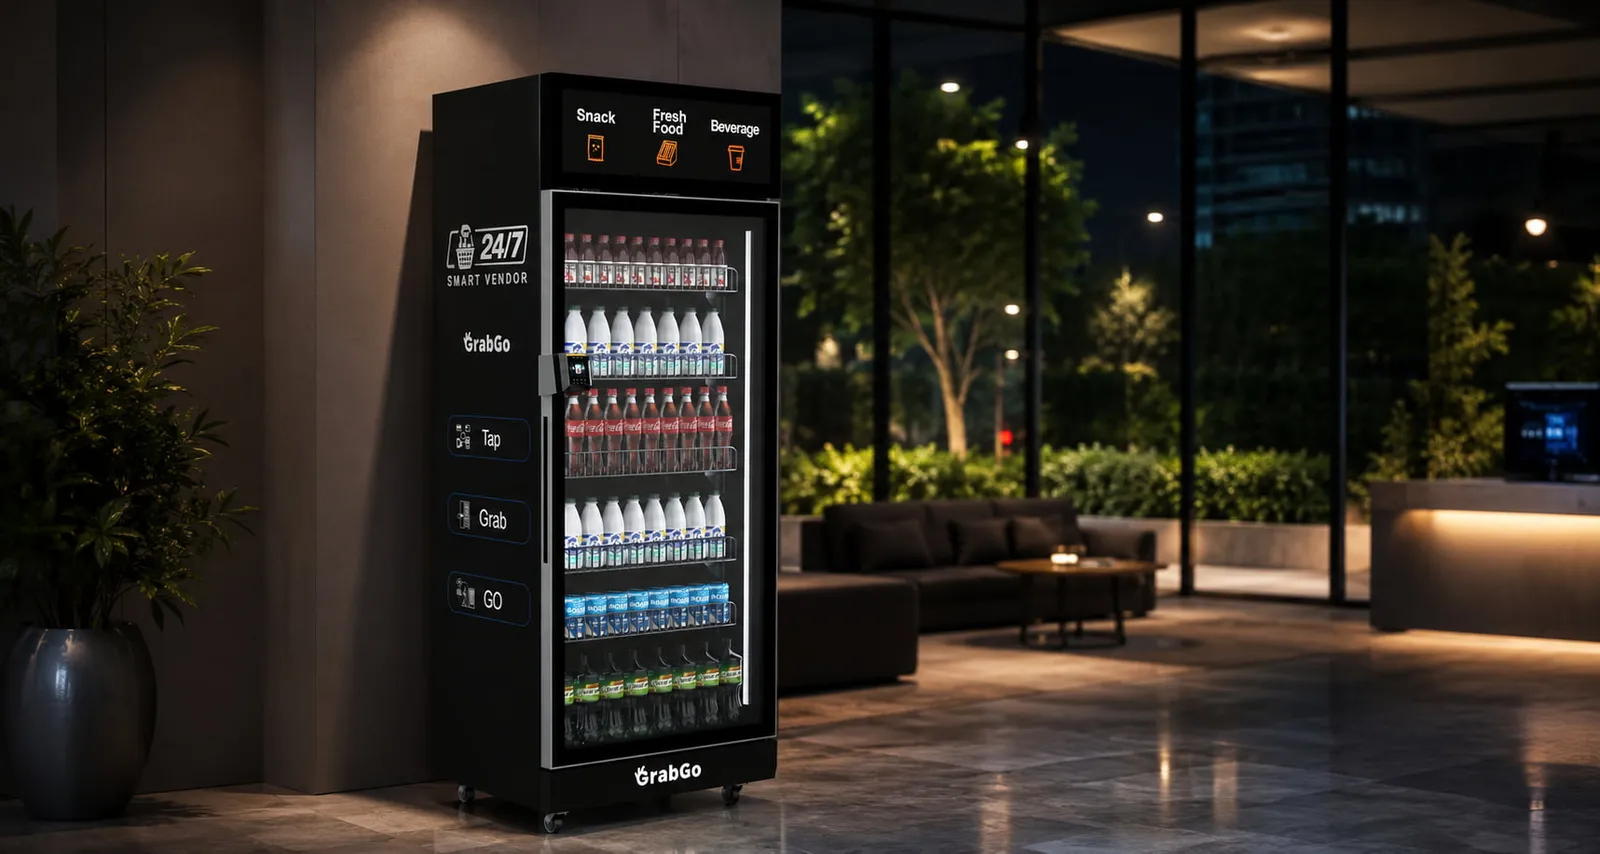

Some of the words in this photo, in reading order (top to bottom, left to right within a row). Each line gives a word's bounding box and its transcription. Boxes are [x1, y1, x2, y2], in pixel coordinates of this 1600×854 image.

[576, 107, 616, 124] Snack
[652, 108, 687, 123] Fresh
[652, 120, 684, 135] Food
[710, 119, 760, 138] Beverage
[480, 230, 524, 260] 24/7
[447, 274, 480, 287] SMART
[485, 272, 528, 286] VENDOR
[463, 332, 511, 353] GrabGo
[481, 429, 501, 451] Tap
[478, 508, 507, 530] Grab
[483, 589, 503, 610] GO
[634, 763, 702, 787] GrabGo
